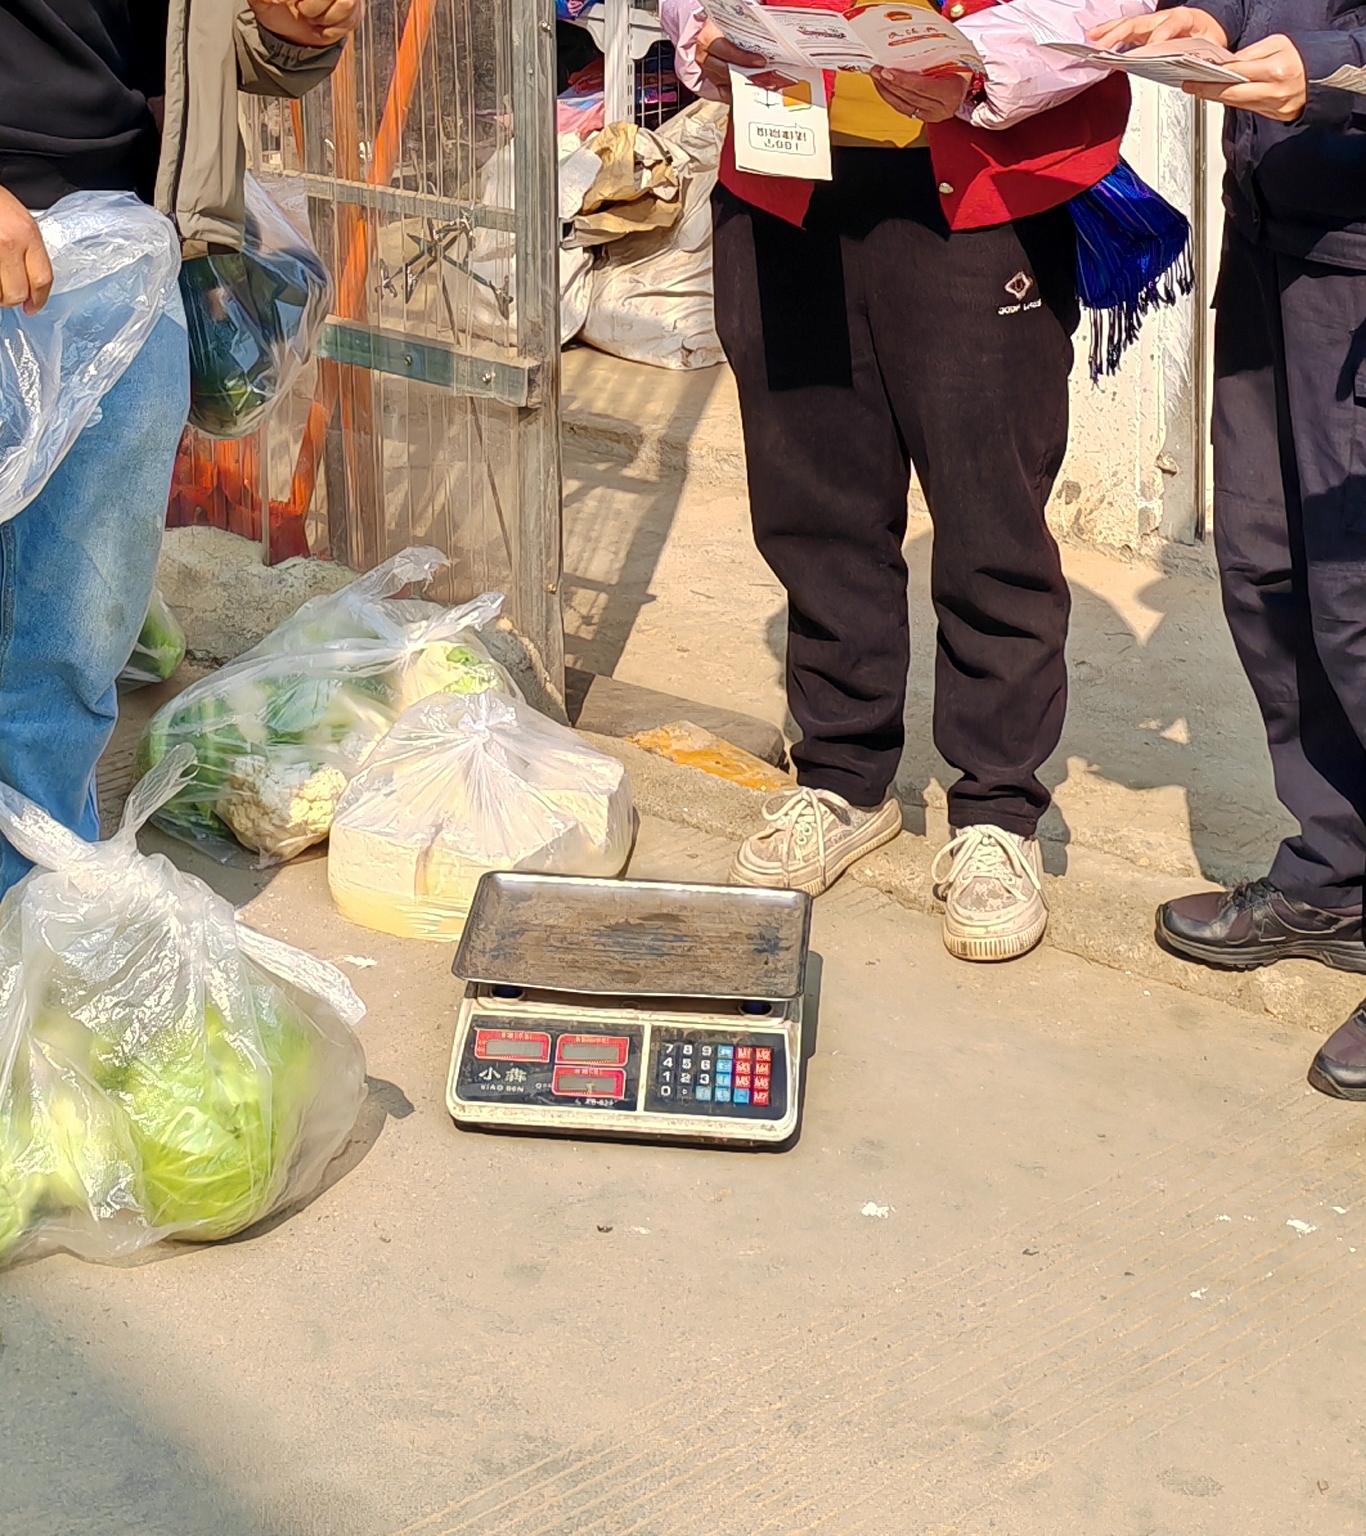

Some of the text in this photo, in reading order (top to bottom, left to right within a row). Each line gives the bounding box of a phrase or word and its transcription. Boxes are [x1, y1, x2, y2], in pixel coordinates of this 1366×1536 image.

[664, 1044, 675, 1054] 7
[683, 1044, 693, 1055] 8
[701, 1045, 712, 1056] 9
[662, 1056, 673, 1068] 4
[682, 1058, 692, 1069] 5
[700, 1059, 711, 1070] 6
[662, 1071, 671, 1082] 1
[680, 1072, 691, 1083] 2
[699, 1073, 710, 1084] 3
[660, 1085, 671, 1096] 0
